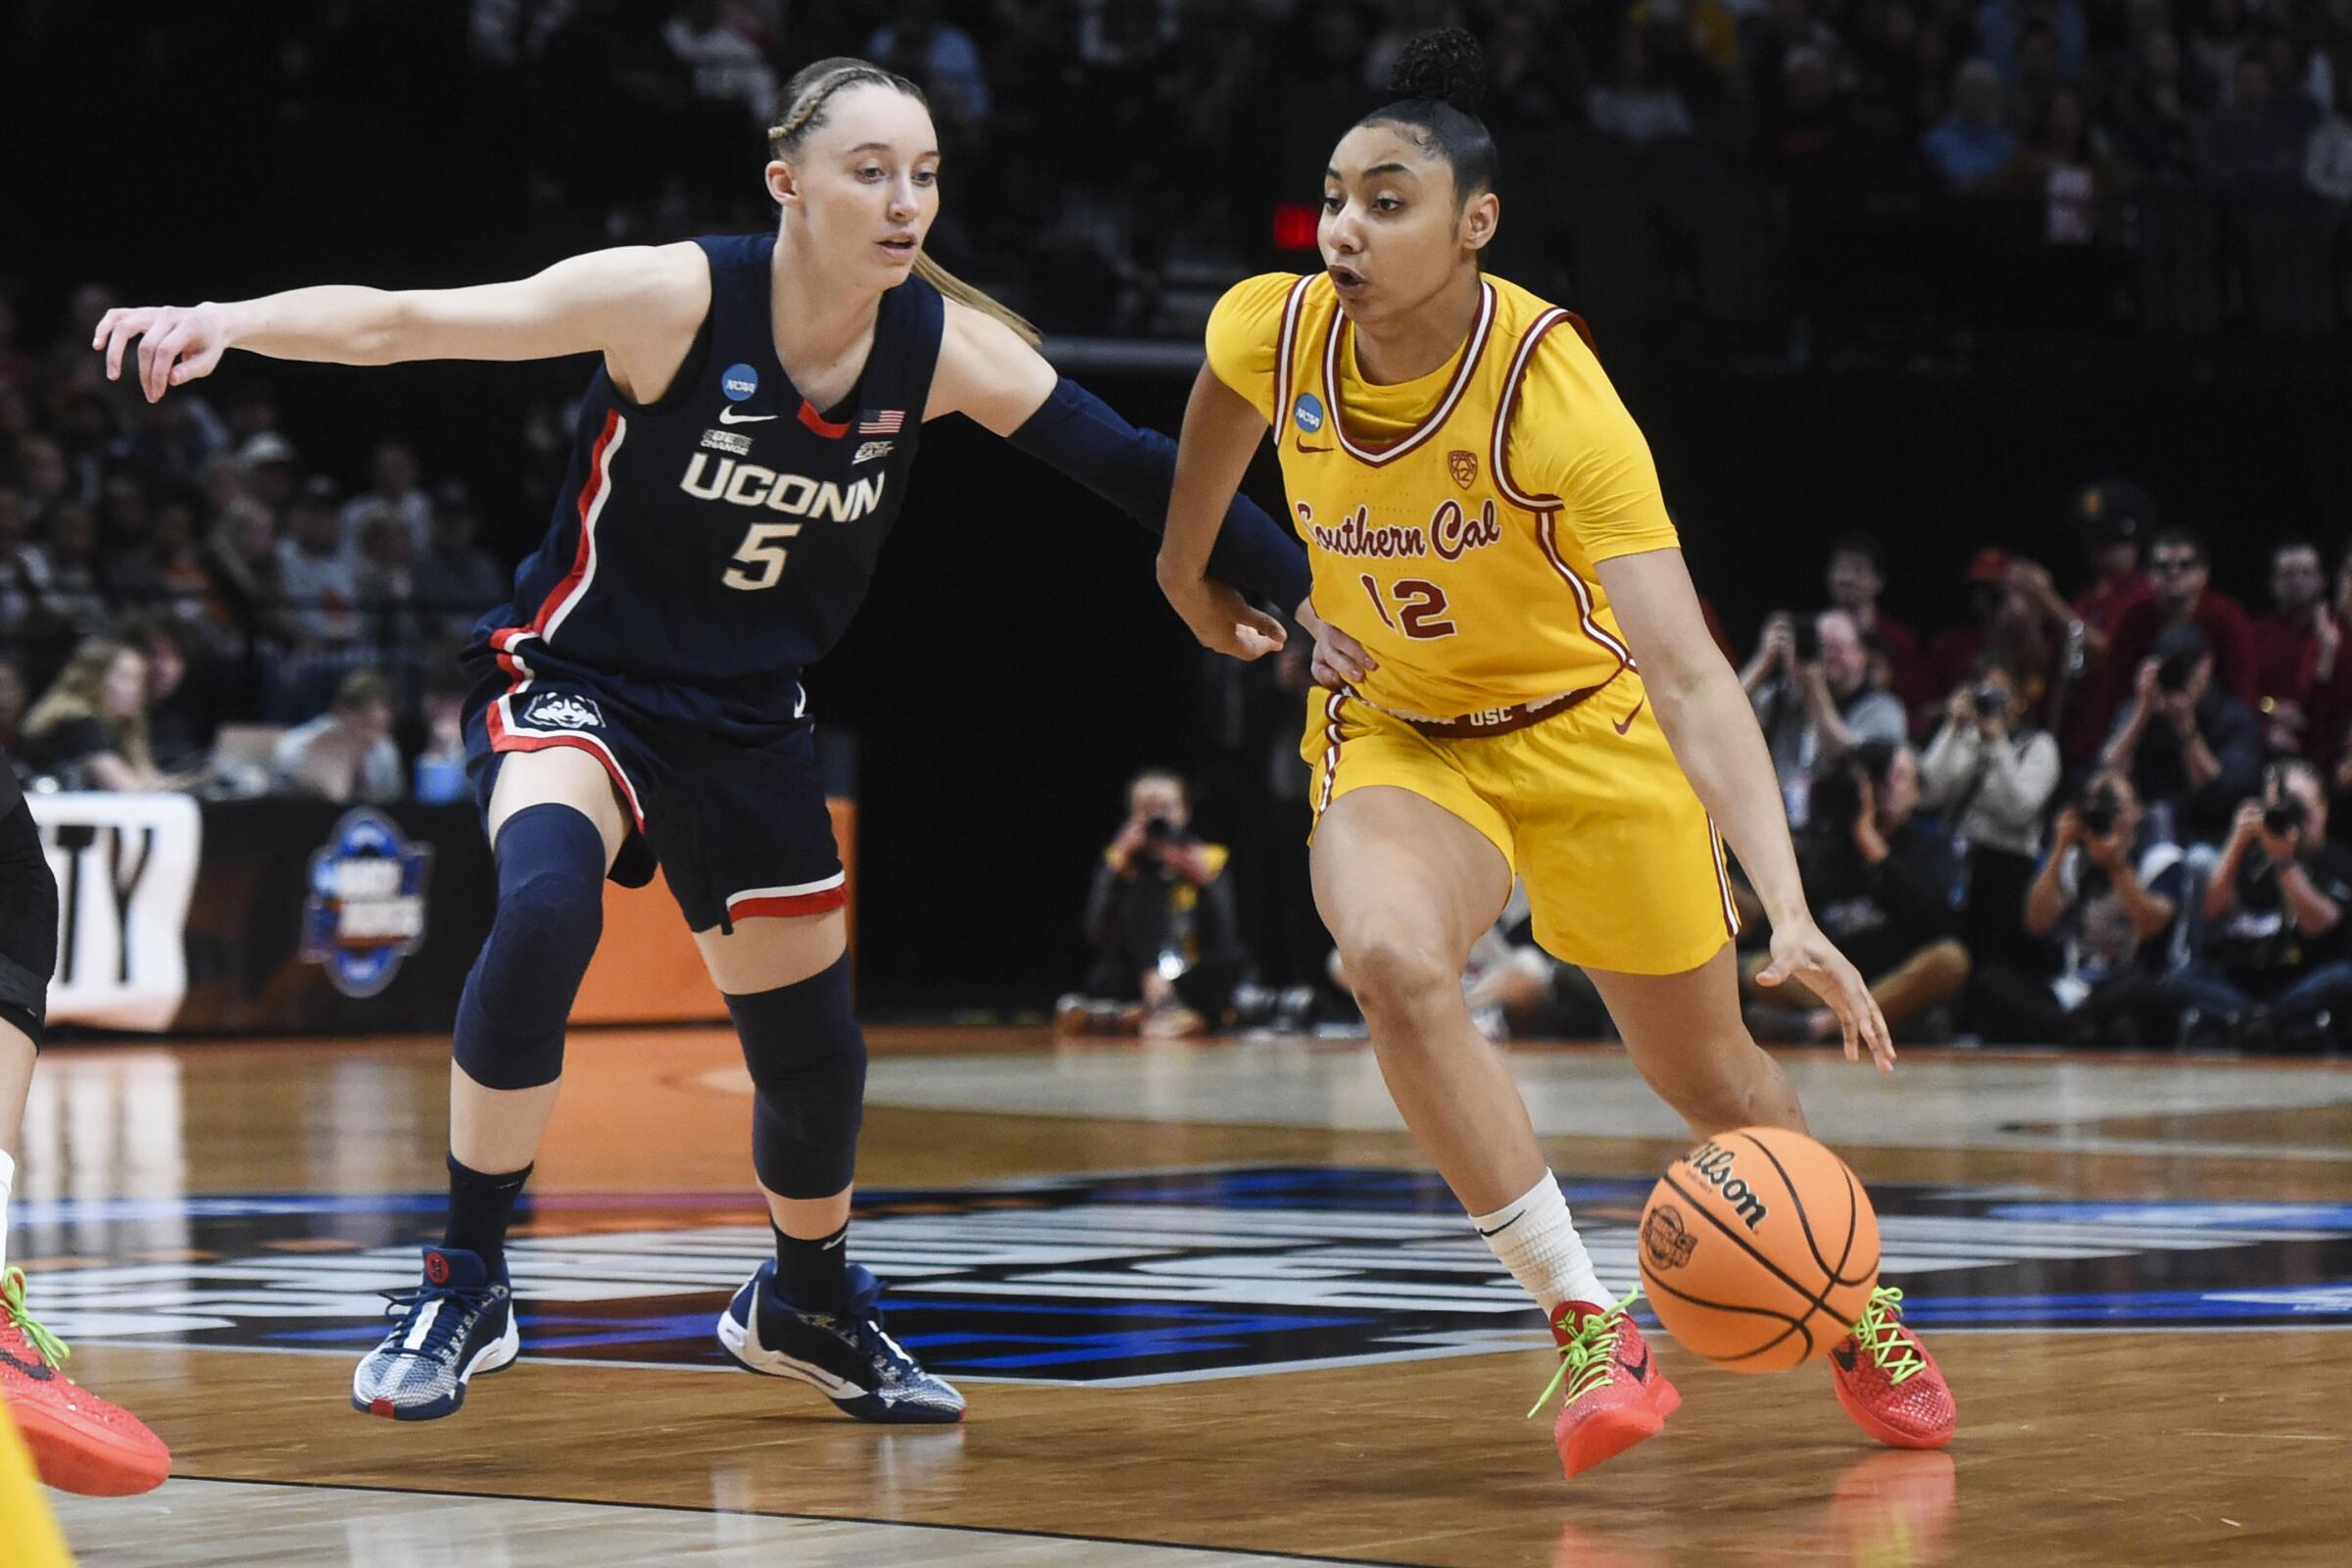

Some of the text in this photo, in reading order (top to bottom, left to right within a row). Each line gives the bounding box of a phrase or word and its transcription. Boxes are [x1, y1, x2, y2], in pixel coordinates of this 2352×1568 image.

[680, 452, 885, 522] UCONN
[721, 522, 803, 591] 5
[1431, 498, 1502, 563] Cal
[1359, 572, 1458, 641] 12
[1469, 705, 1514, 727] USC
[39, 823, 156, 985] TY
